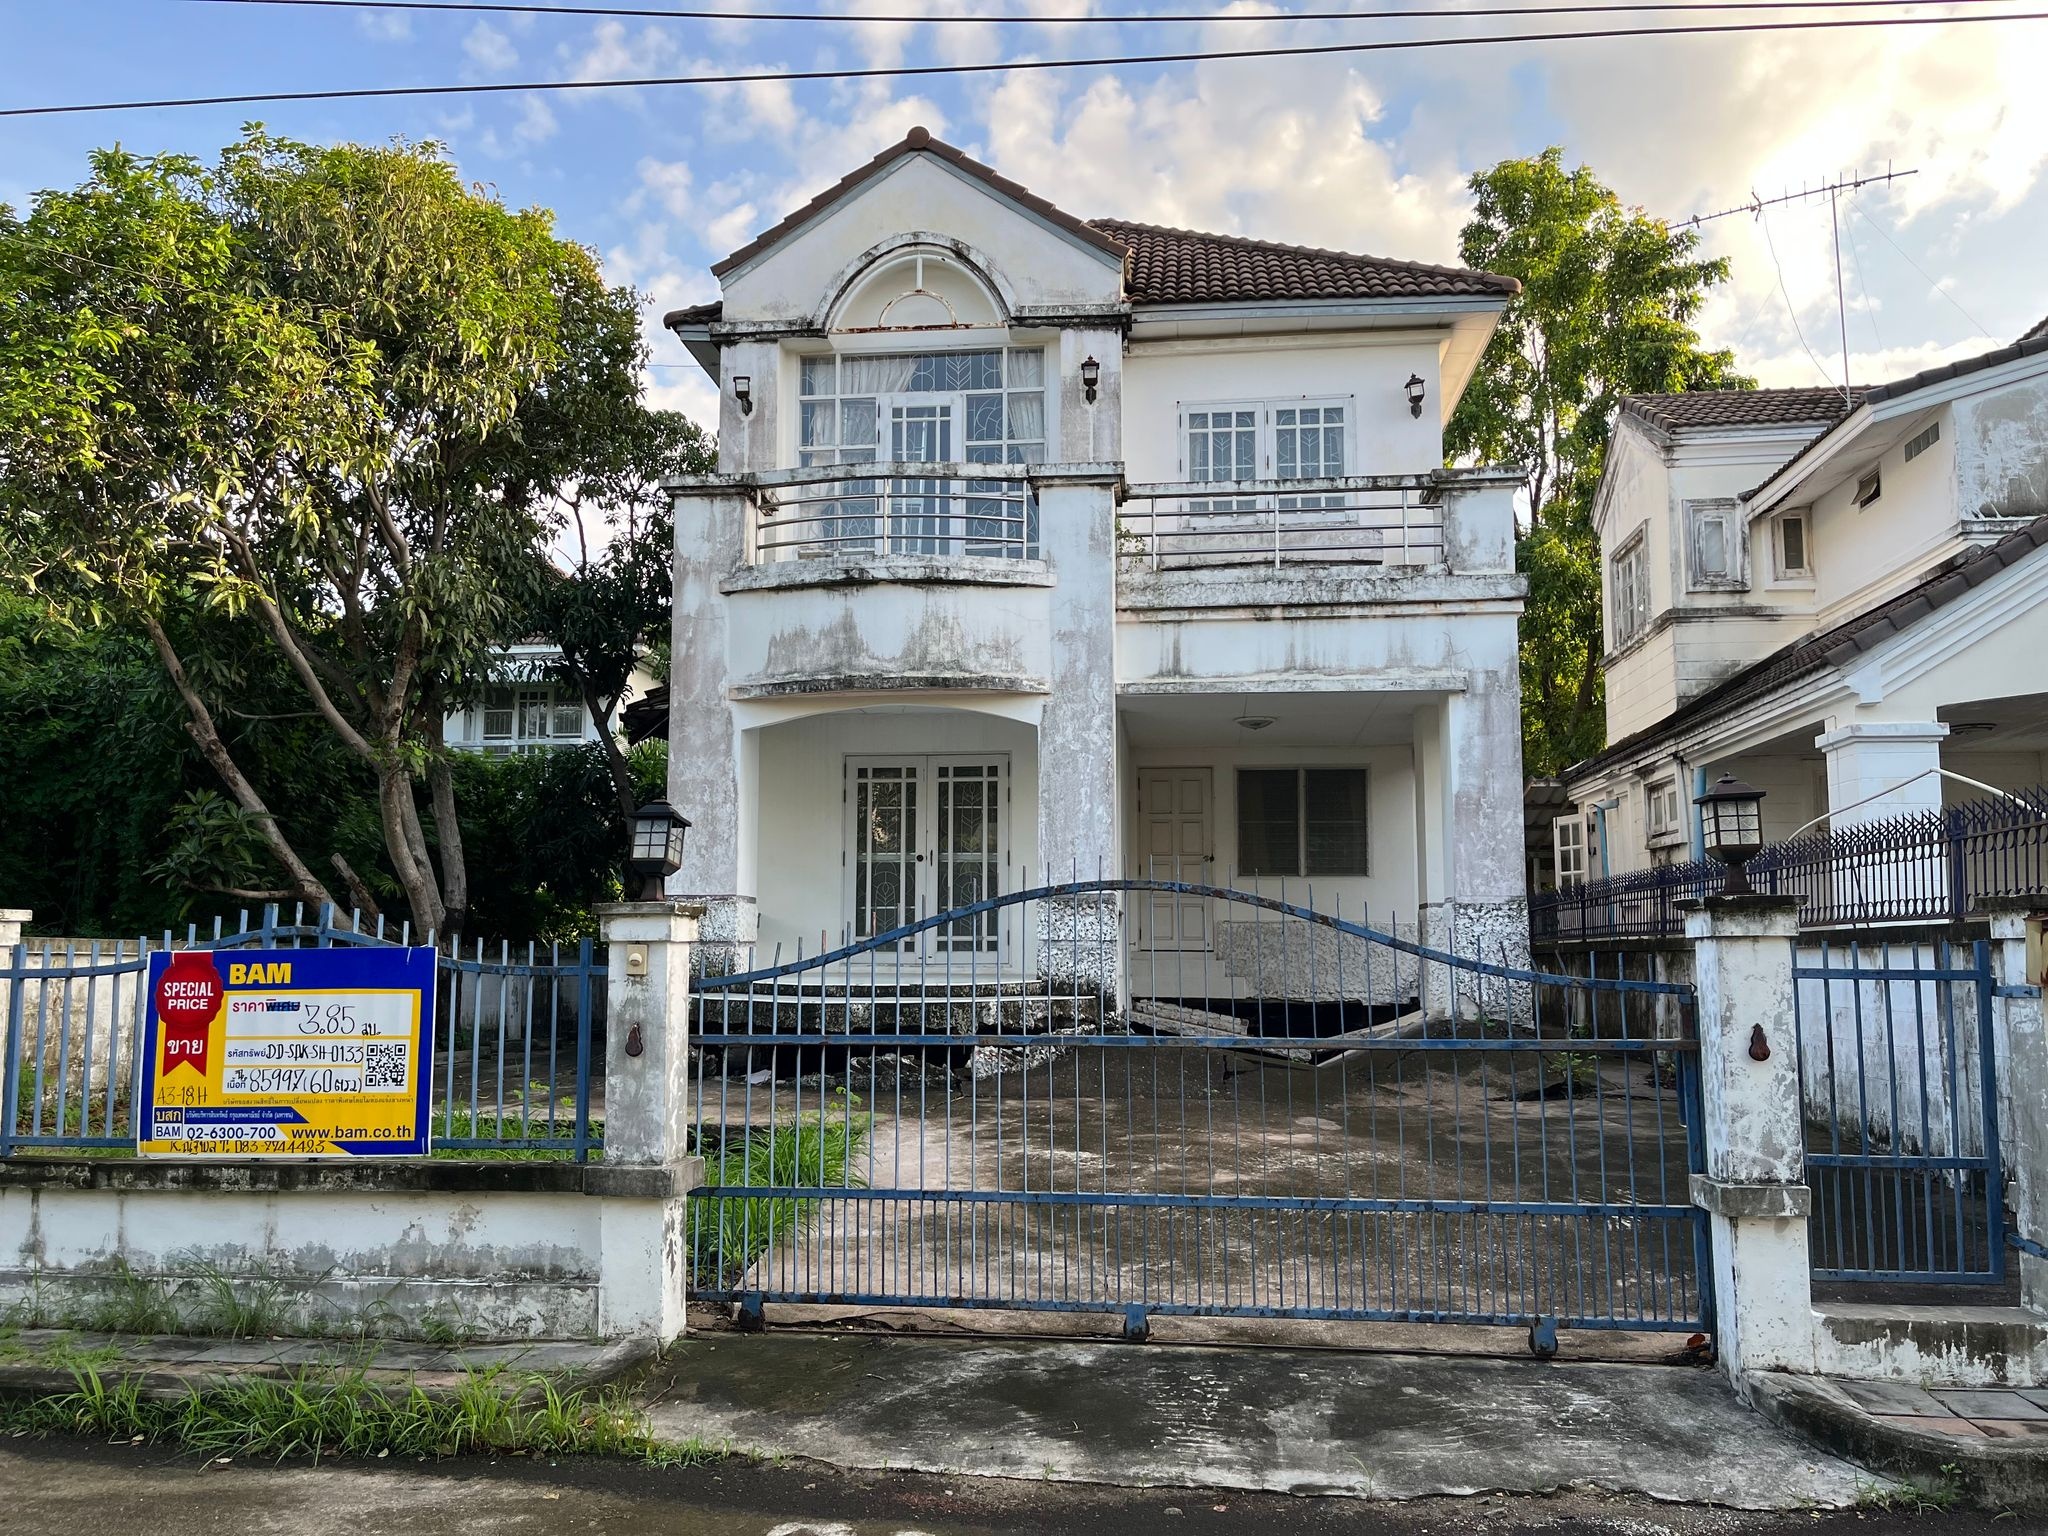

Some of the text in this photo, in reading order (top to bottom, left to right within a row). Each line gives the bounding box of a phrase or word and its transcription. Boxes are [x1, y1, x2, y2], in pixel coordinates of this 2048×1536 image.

[229, 963, 292, 985] BAM
[164, 982, 214, 997] SPECIAL
[168, 999, 208, 1010] PRICE
[298, 1004, 356, 1035] 3.85
[167, 1038, 204, 1055] ขาย
[227, 1047, 266, 1058] รหัสทรัพย์
[155, 1109, 181, 1122] บสก
[156, 1125, 181, 1137] BAM
[187, 1126, 276, 1140] 02-6300-700
[291, 1125, 411, 1139] www.bam.co.th
